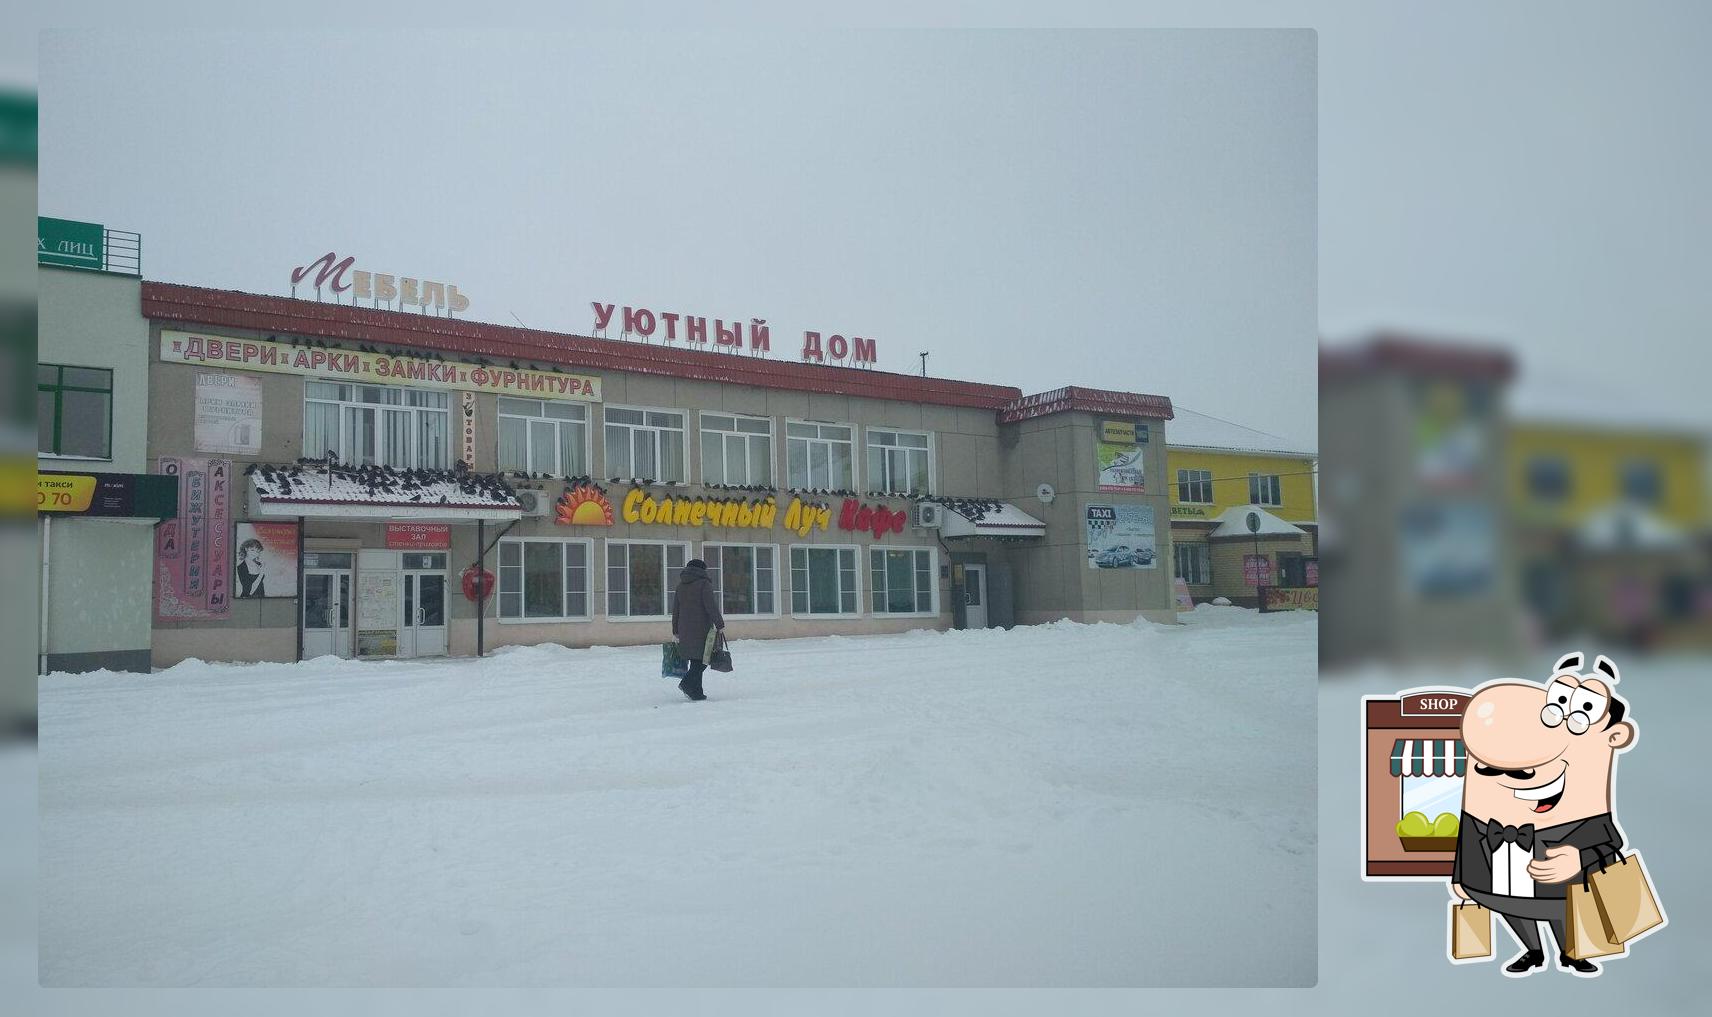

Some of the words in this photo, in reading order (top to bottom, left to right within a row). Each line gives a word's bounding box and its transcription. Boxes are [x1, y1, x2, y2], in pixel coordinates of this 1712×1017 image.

[592, 302, 770, 352] УЮТНЫЙ
[803, 331, 877, 363] ДОМ
[184, 337, 277, 365] ДВЕРИ
[293, 350, 359, 374] АРКИ
[375, 357, 457, 383] ЗАМКИ
[470, 367, 595, 397] ФУРНИТУРА
[45, 481, 73, 489] такси
[52, 492, 72, 506] 70
[622, 487, 776, 529] Солнечный
[784, 497, 832, 537] Луч
[838, 498, 907, 540] Кафе
[1091, 508, 1111, 518] TAXI
[210, 466, 225, 605] АКСЕССУАРЫ
[410, 533, 427, 541] ЗАЛ
